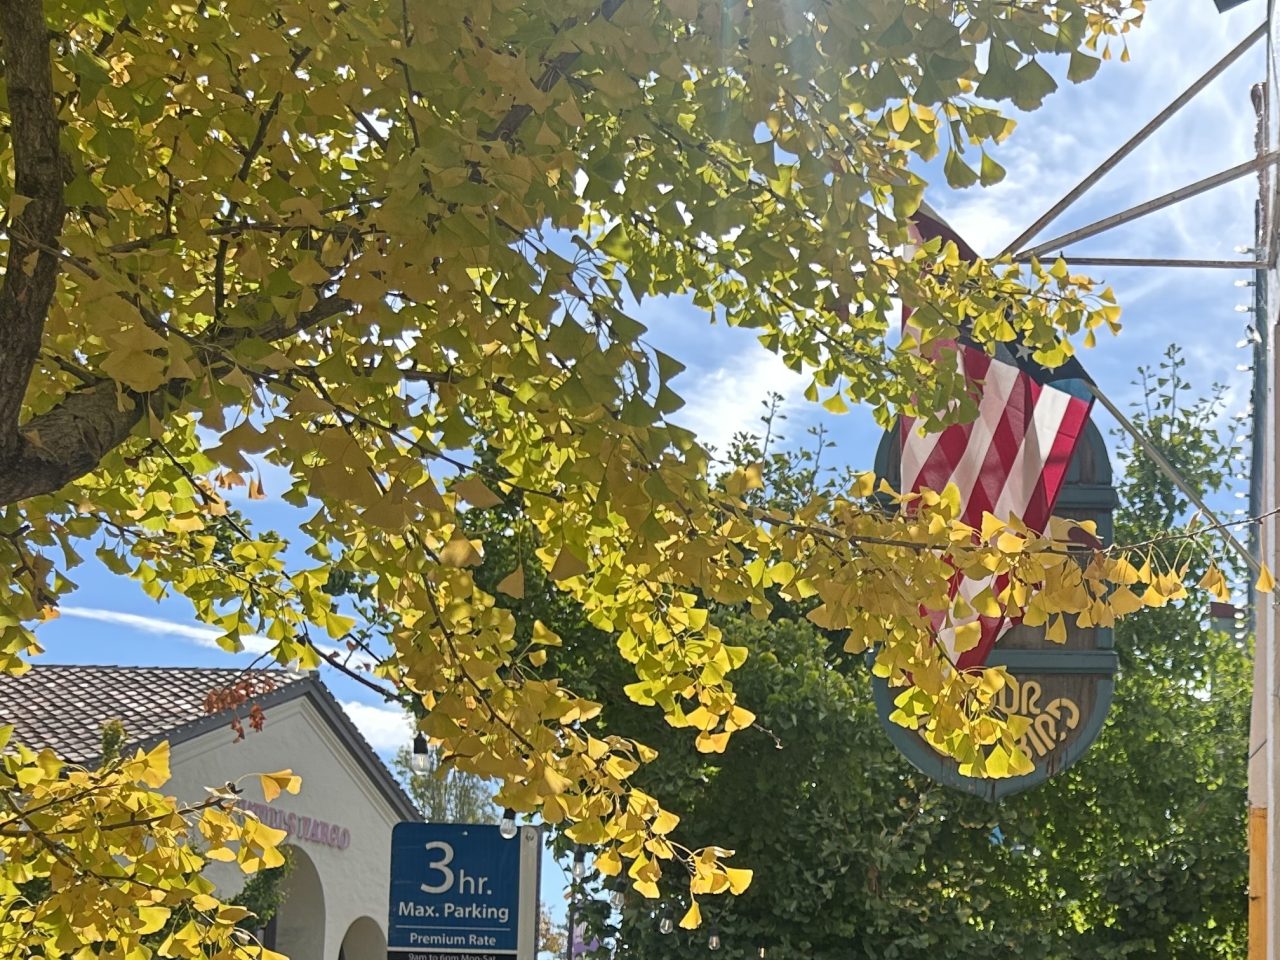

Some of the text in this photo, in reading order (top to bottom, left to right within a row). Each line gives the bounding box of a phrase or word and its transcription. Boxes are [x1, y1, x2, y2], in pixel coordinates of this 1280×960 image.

[420, 841, 492, 895] 3 hr.
[398, 902, 509, 923] Max. Parking
[409, 932, 496, 946] Premium Rate
